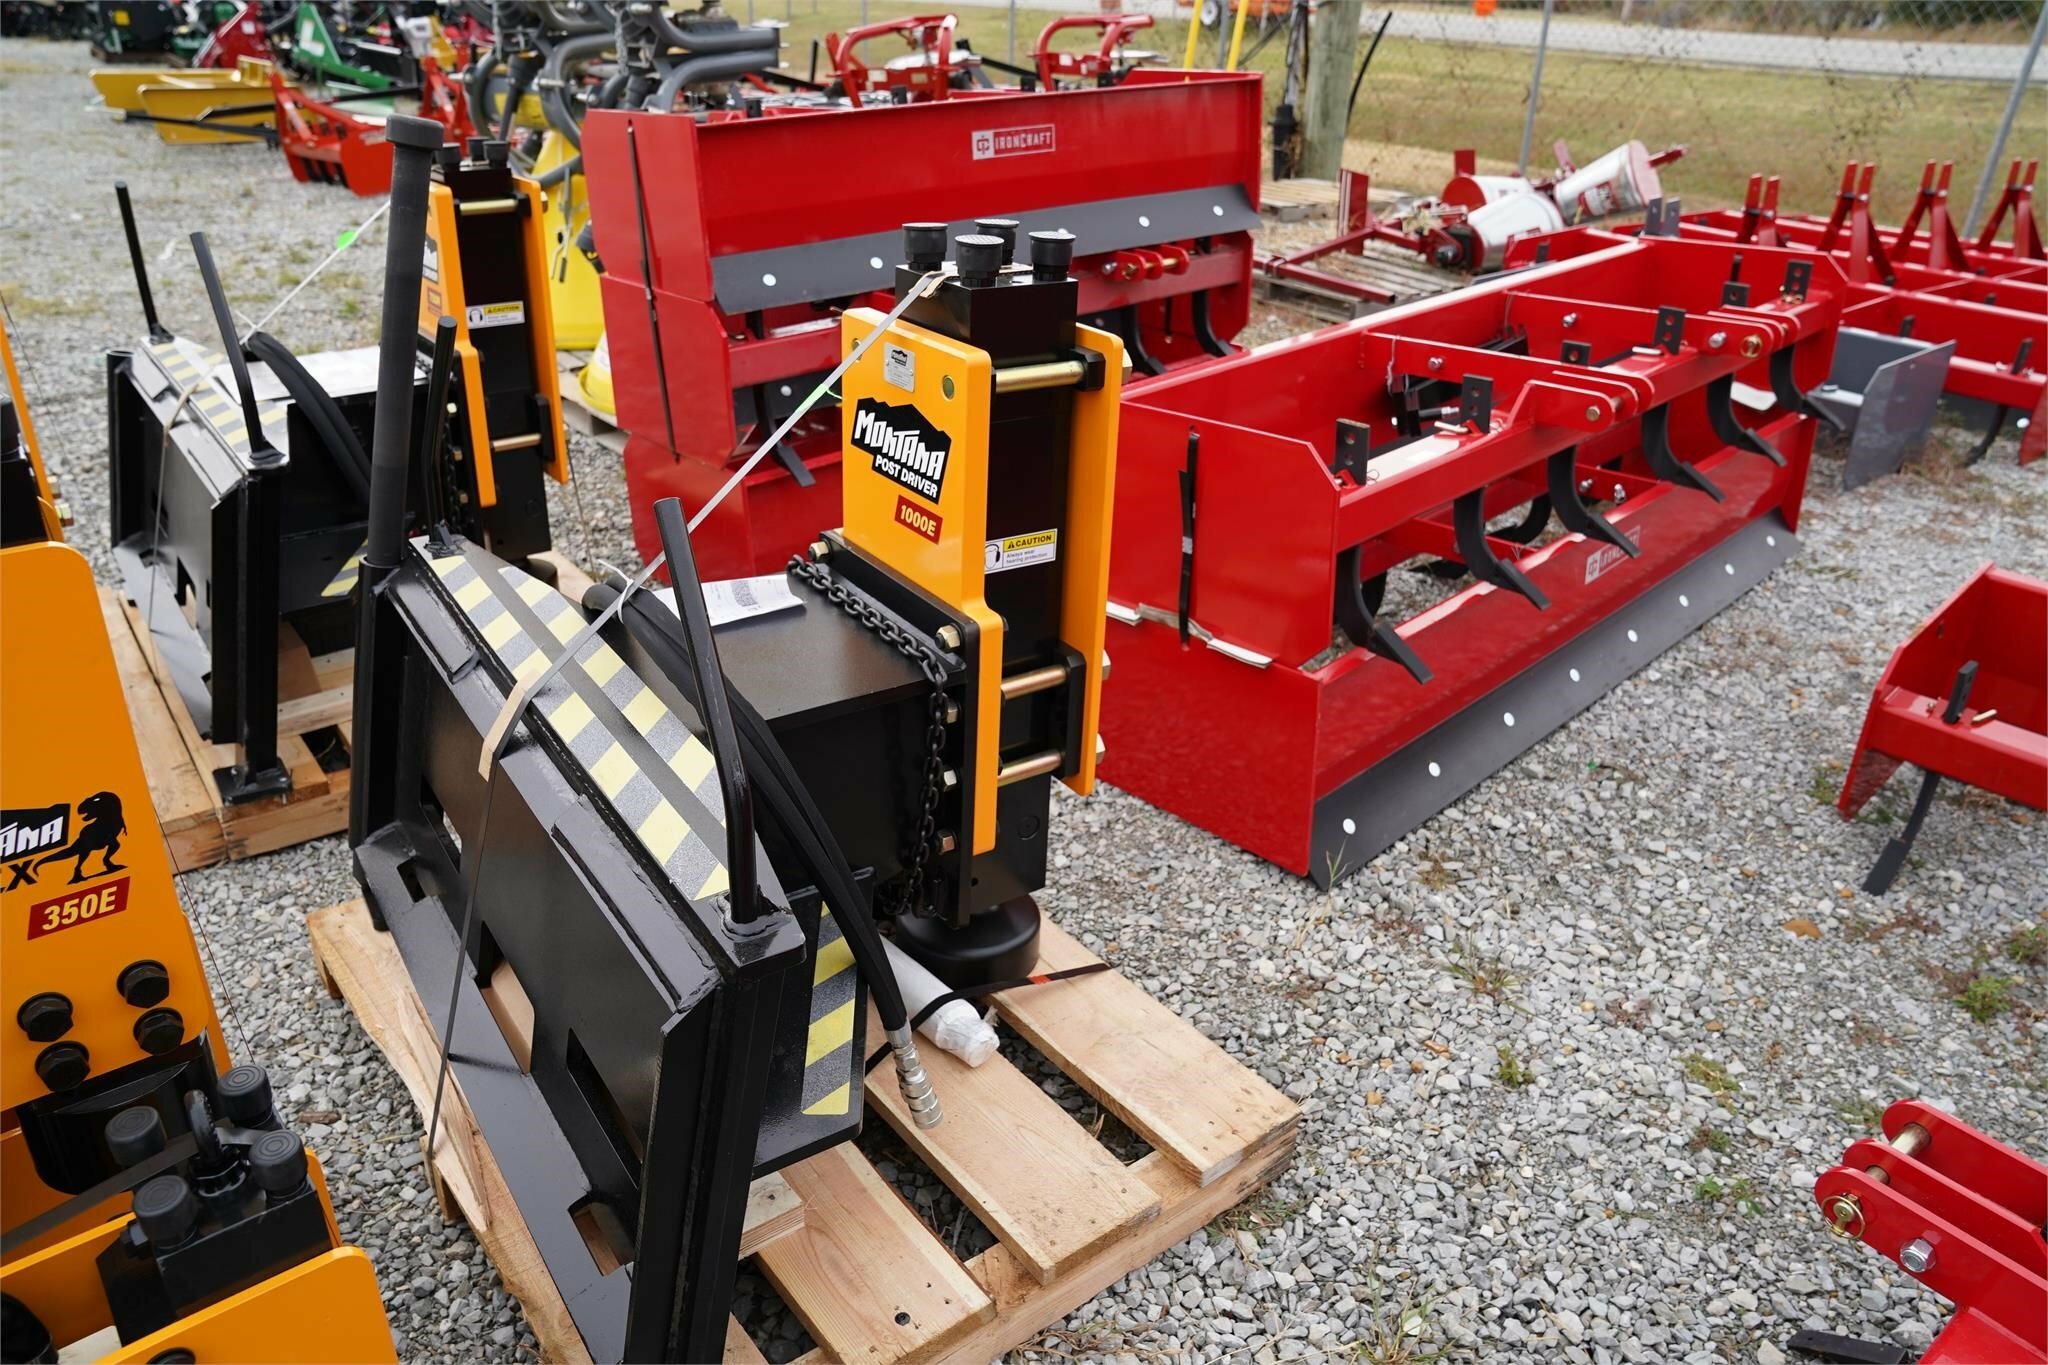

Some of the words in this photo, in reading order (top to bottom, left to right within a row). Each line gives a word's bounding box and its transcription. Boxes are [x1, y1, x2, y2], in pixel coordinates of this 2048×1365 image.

[995, 132, 1051, 150] IRONCRAFT
[854, 409, 946, 480] MONTANA
[875, 454, 901, 478] POST
[900, 467, 939, 498] DRIVER
[900, 504, 937, 537] 1000E
[1015, 535, 1052, 547] CAUTION
[42, 886, 117, 931] 350E
